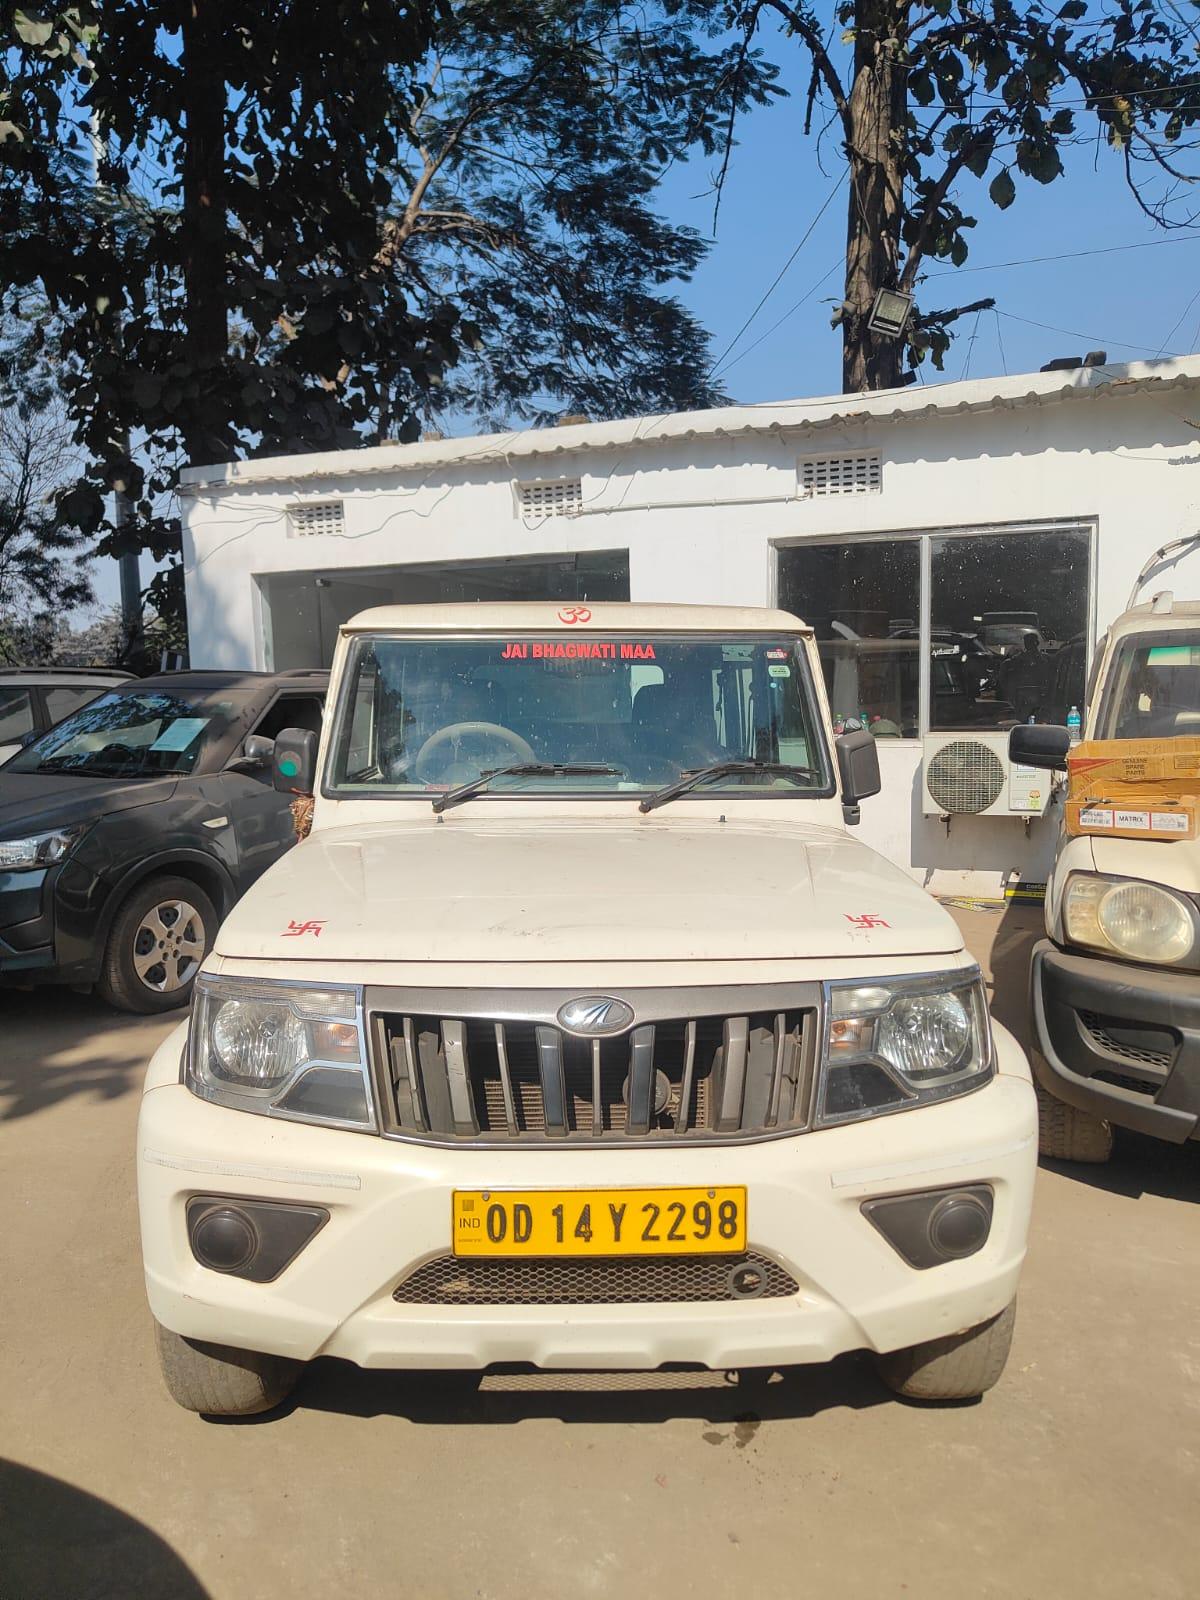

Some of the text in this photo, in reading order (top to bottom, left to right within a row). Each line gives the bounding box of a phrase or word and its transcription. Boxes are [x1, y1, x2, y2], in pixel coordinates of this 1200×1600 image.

[501, 643, 656, 658] JAI BHAGWATI MAA
[459, 1217, 481, 1229] IND
[486, 1200, 738, 1243] OD 14 Y 2298
